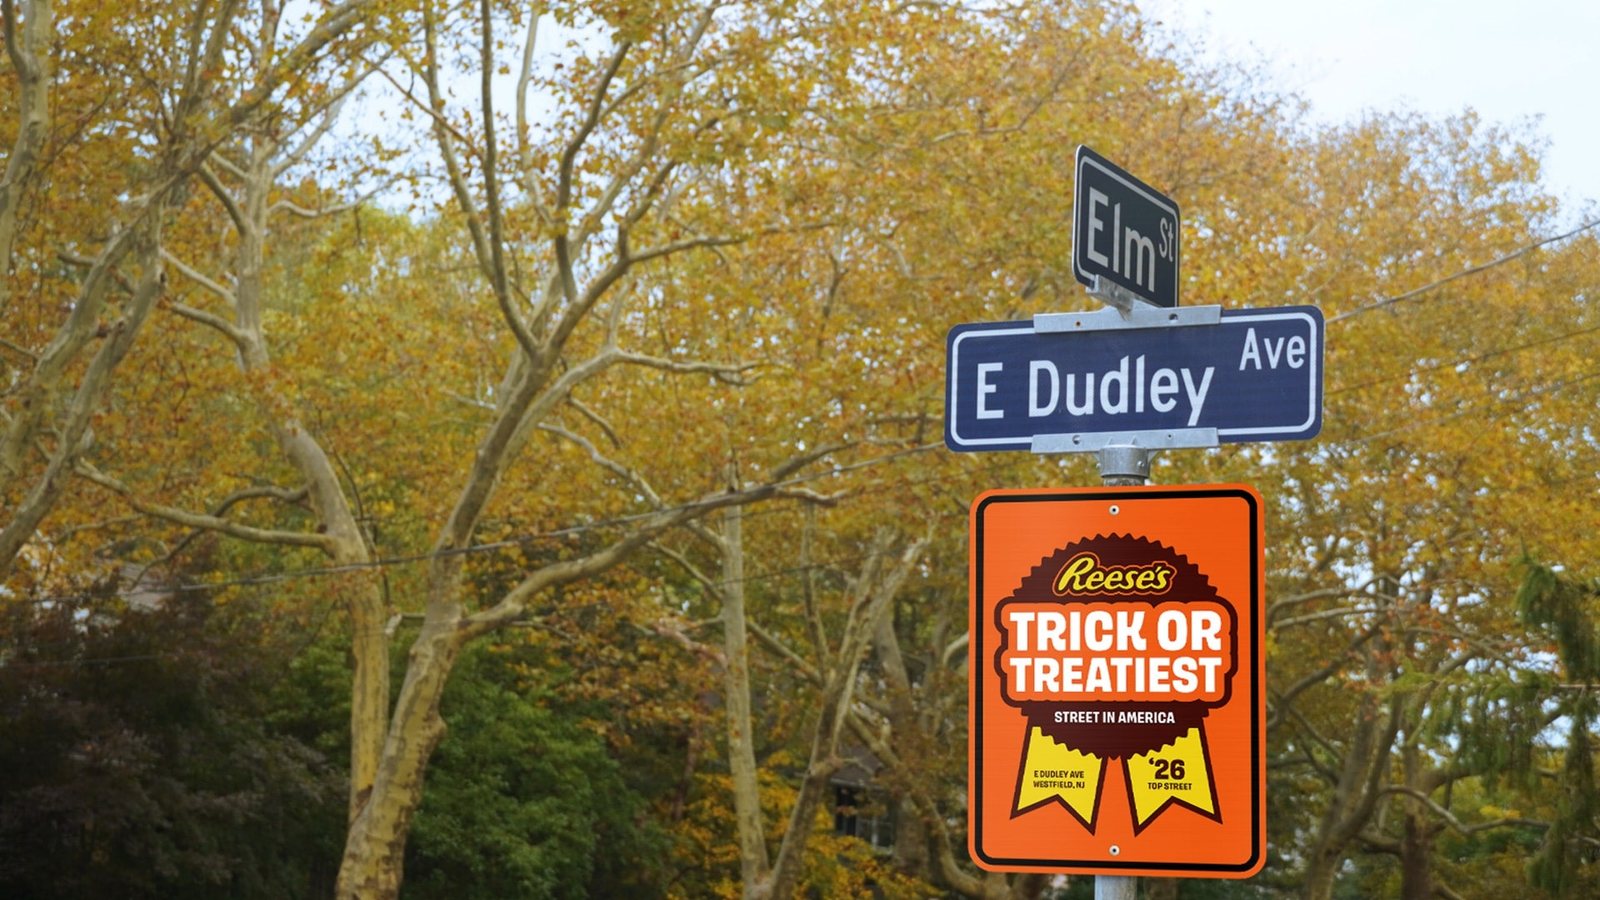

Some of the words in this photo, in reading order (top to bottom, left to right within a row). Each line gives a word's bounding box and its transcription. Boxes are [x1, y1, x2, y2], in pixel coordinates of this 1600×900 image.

[1087, 187, 1155, 293] Elm
[1159, 217, 1174, 262] St
[976, 362, 1004, 420] E
[1028, 354, 1215, 426] Dudley
[1239, 327, 1306, 370] Ave
[1058, 557, 1170, 591] Reese's
[1009, 610, 1147, 651] TRICK
[1157, 609, 1222, 651] OR
[1009, 656, 1222, 693] TREATIEST
[1054, 711, 1099, 723] STREET
[1102, 711, 1115, 723] IN
[1118, 711, 1175, 724] AMERICA
[1033, 780, 1075, 789] WESTFIELD,
[1076, 781, 1085, 789] NJ
[1040, 770, 1069, 778] DUDLEY
[1070, 770, 1084, 778] AVE
[1148, 782, 1163, 790] TOP
[1164, 782, 1192, 790] STREET
